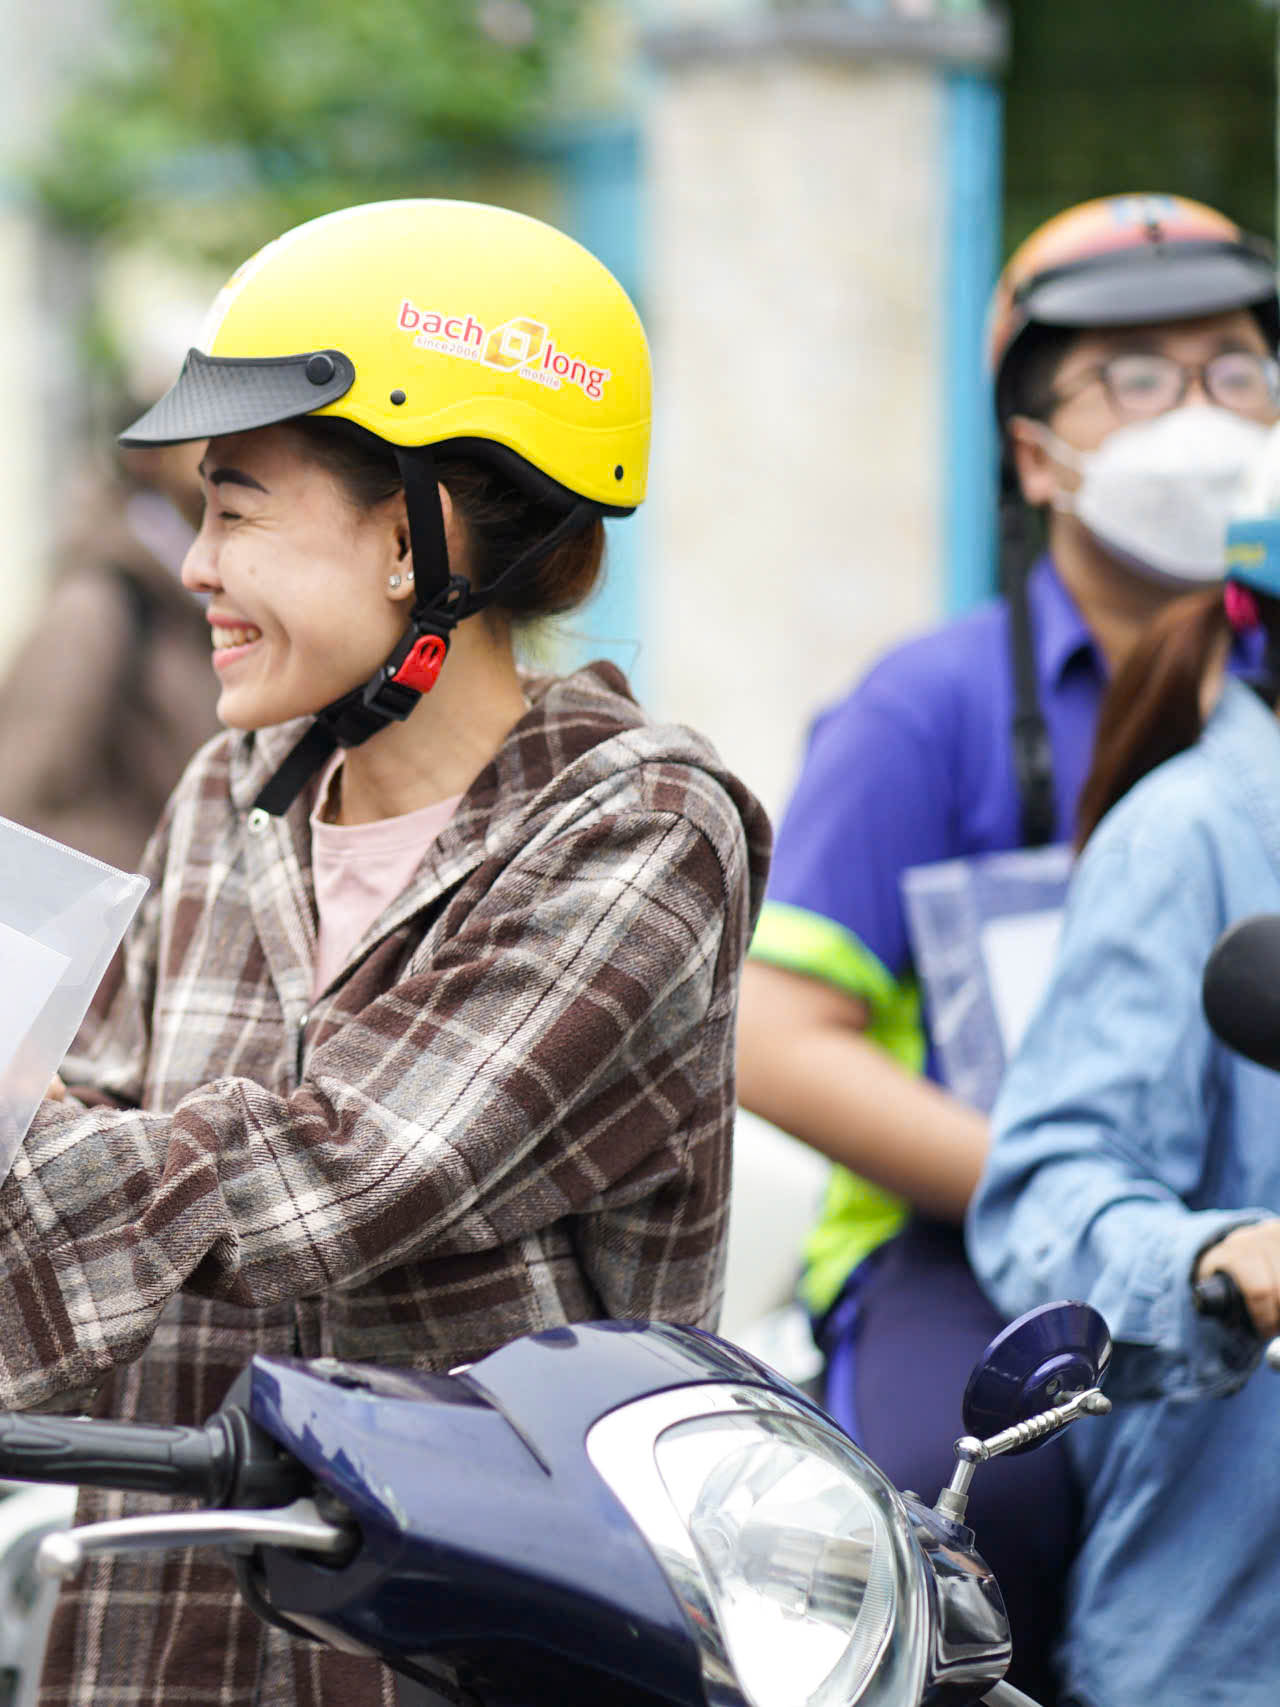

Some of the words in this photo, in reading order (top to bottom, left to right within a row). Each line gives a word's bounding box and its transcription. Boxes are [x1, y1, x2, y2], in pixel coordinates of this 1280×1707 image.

[400, 302, 483, 345] bach
[544, 344, 605, 398] long
[520, 367, 560, 388] mobile
